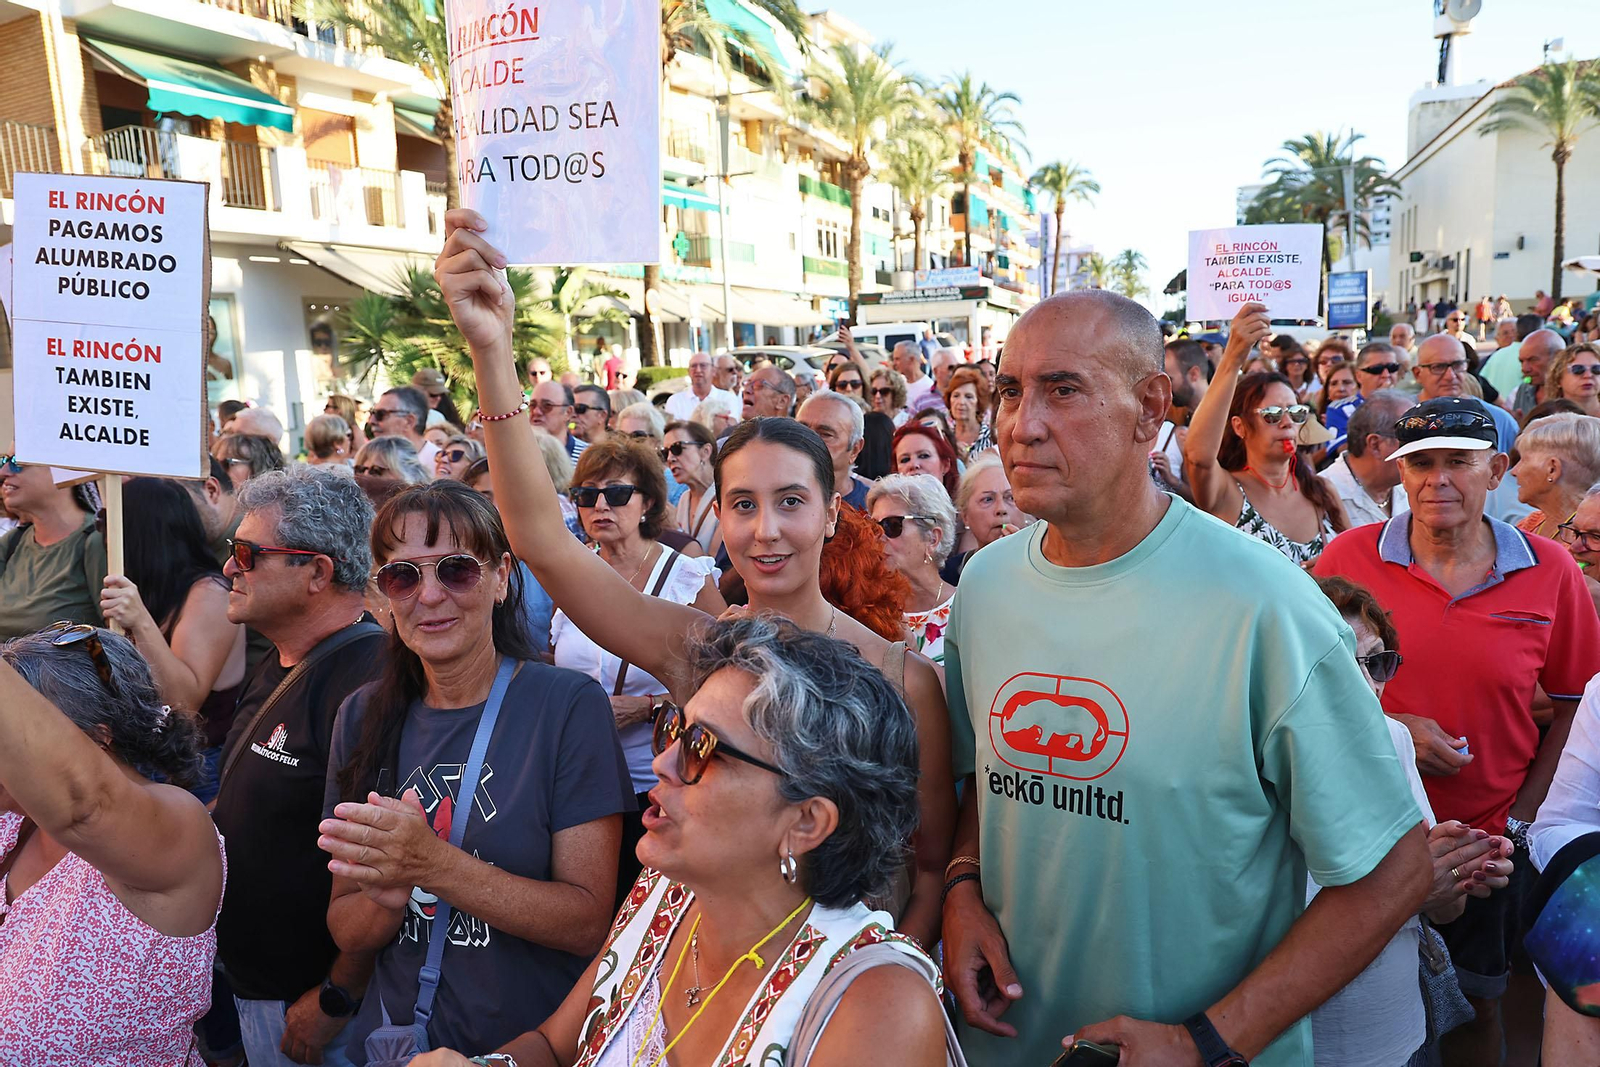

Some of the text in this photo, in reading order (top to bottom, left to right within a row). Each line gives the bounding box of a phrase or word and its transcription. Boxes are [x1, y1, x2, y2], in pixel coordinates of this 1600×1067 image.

[457, 3, 539, 52] RINCÓN
[568, 100, 619, 131] SEA
[502, 151, 606, 184] TOD@S
[48, 189, 165, 215] EL RINCÓN
[49, 219, 163, 244] PAGAMOS
[1215, 240, 1278, 253] EL RINCÓN
[35, 247, 177, 273] ALUMBRADO
[1205, 253, 1302, 266] TAMBIÉN EXISTE,
[1217, 267, 1274, 278] ALCALDE.
[1249, 279, 1292, 291] TOD@S
[58, 272, 150, 300] PÚBLICO
[47, 337, 162, 363] EL RINCÓN
[55, 366, 151, 391] TAMBIEN
[68, 395, 139, 420] EXISTE,
[59, 423, 149, 446] ALCALDE
[279, 754, 300, 767] FELIX
[1053, 784, 1130, 825] unltd.
